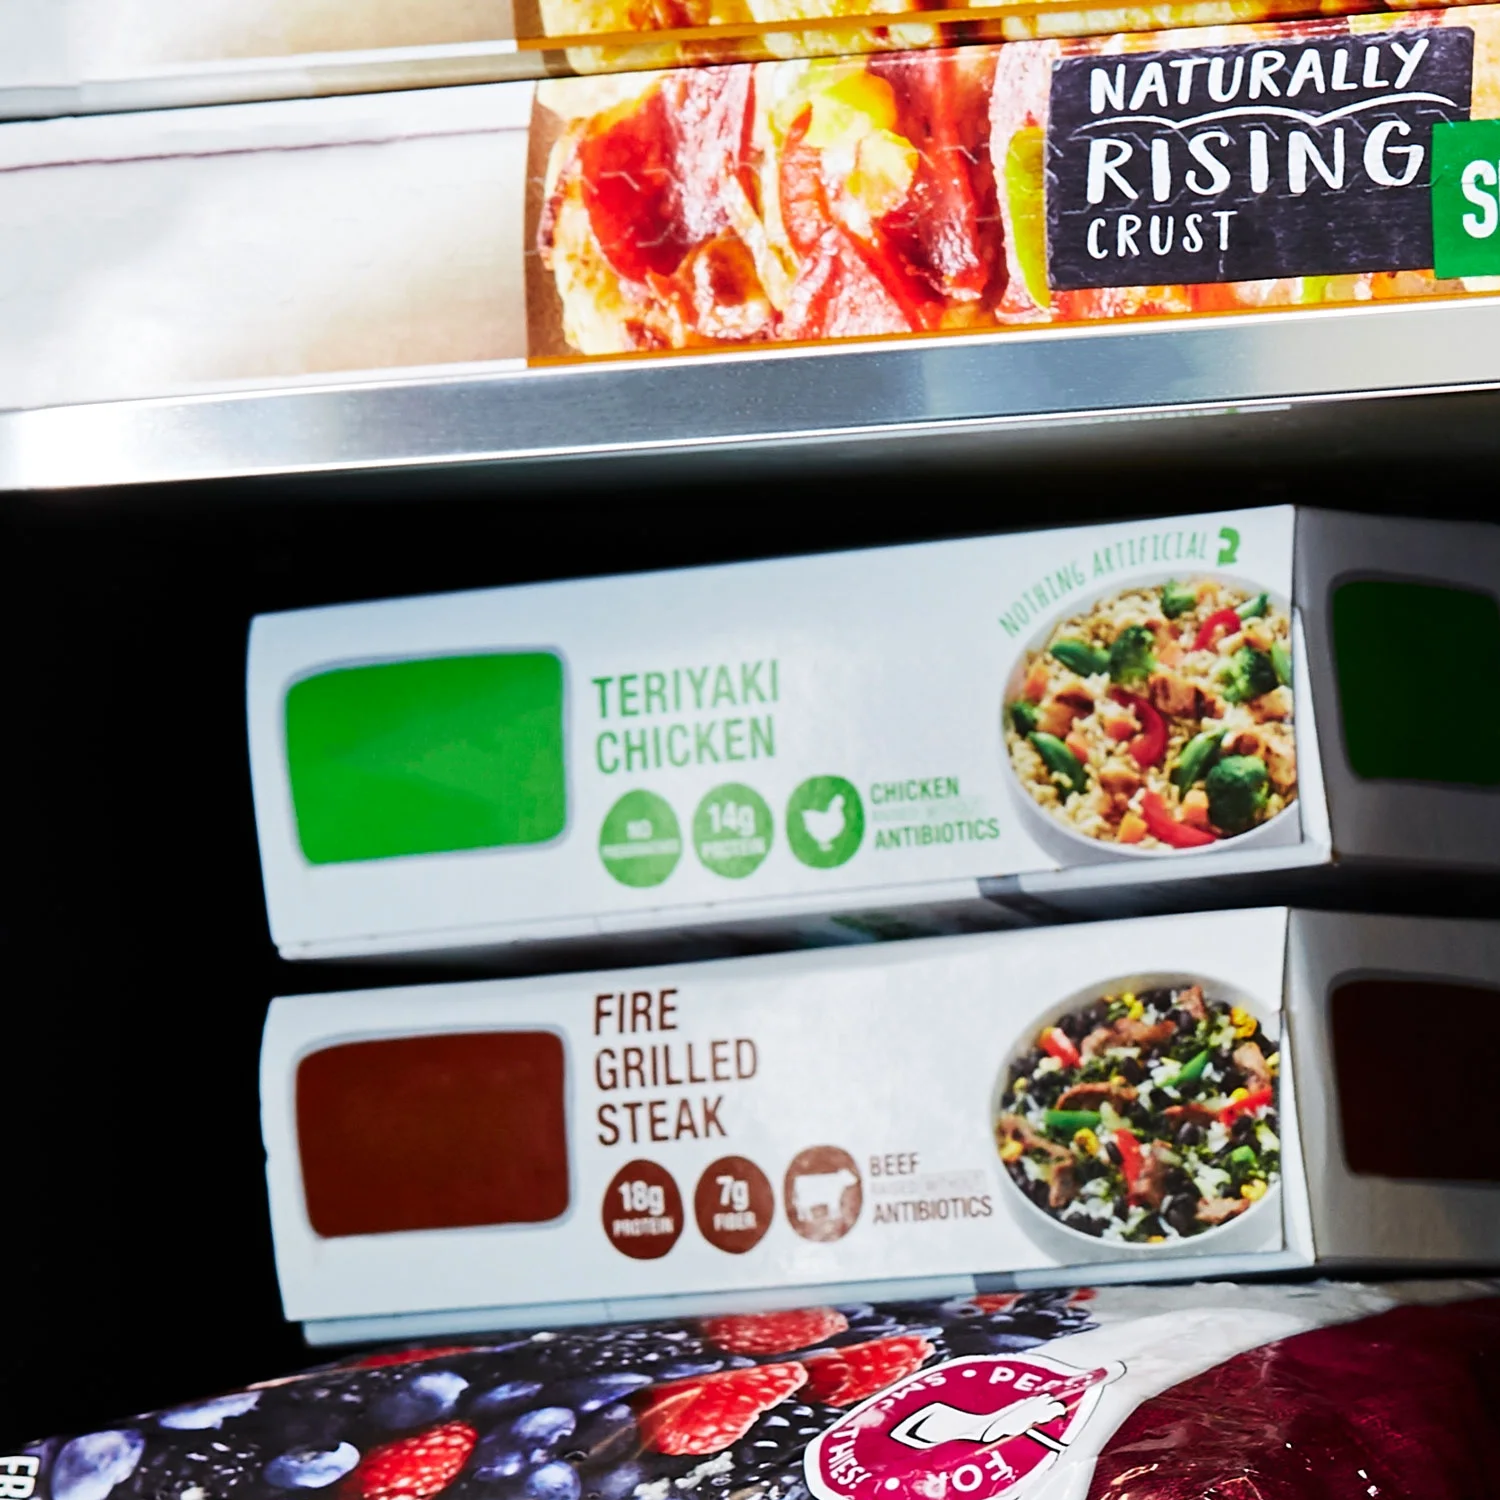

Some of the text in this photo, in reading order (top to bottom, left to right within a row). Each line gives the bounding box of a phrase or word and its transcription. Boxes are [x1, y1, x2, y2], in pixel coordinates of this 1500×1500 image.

[1090, 37, 1431, 115] NATURALLY
[1085, 119, 1425, 202] RISING
[1086, 209, 1238, 259] CRUST
[998, 531, 1208, 638] NOTHING ARTIFICIAL
[592, 658, 781, 719] TERIYAKI
[596, 716, 776, 775] CHICKEN
[870, 775, 960, 805] CHICKEN
[707, 801, 755, 836] 14g
[875, 817, 1001, 850] ANTIBIOTICS
[593, 988, 678, 1036] FIRE
[594, 1038, 758, 1091] GRILLED
[597, 1096, 727, 1146] STEAK
[870, 1151, 921, 1178] BEEF
[618, 1180, 665, 1216] 18g
[716, 1175, 749, 1211] 7g
[873, 1194, 994, 1224] ANTIBIOTICS
